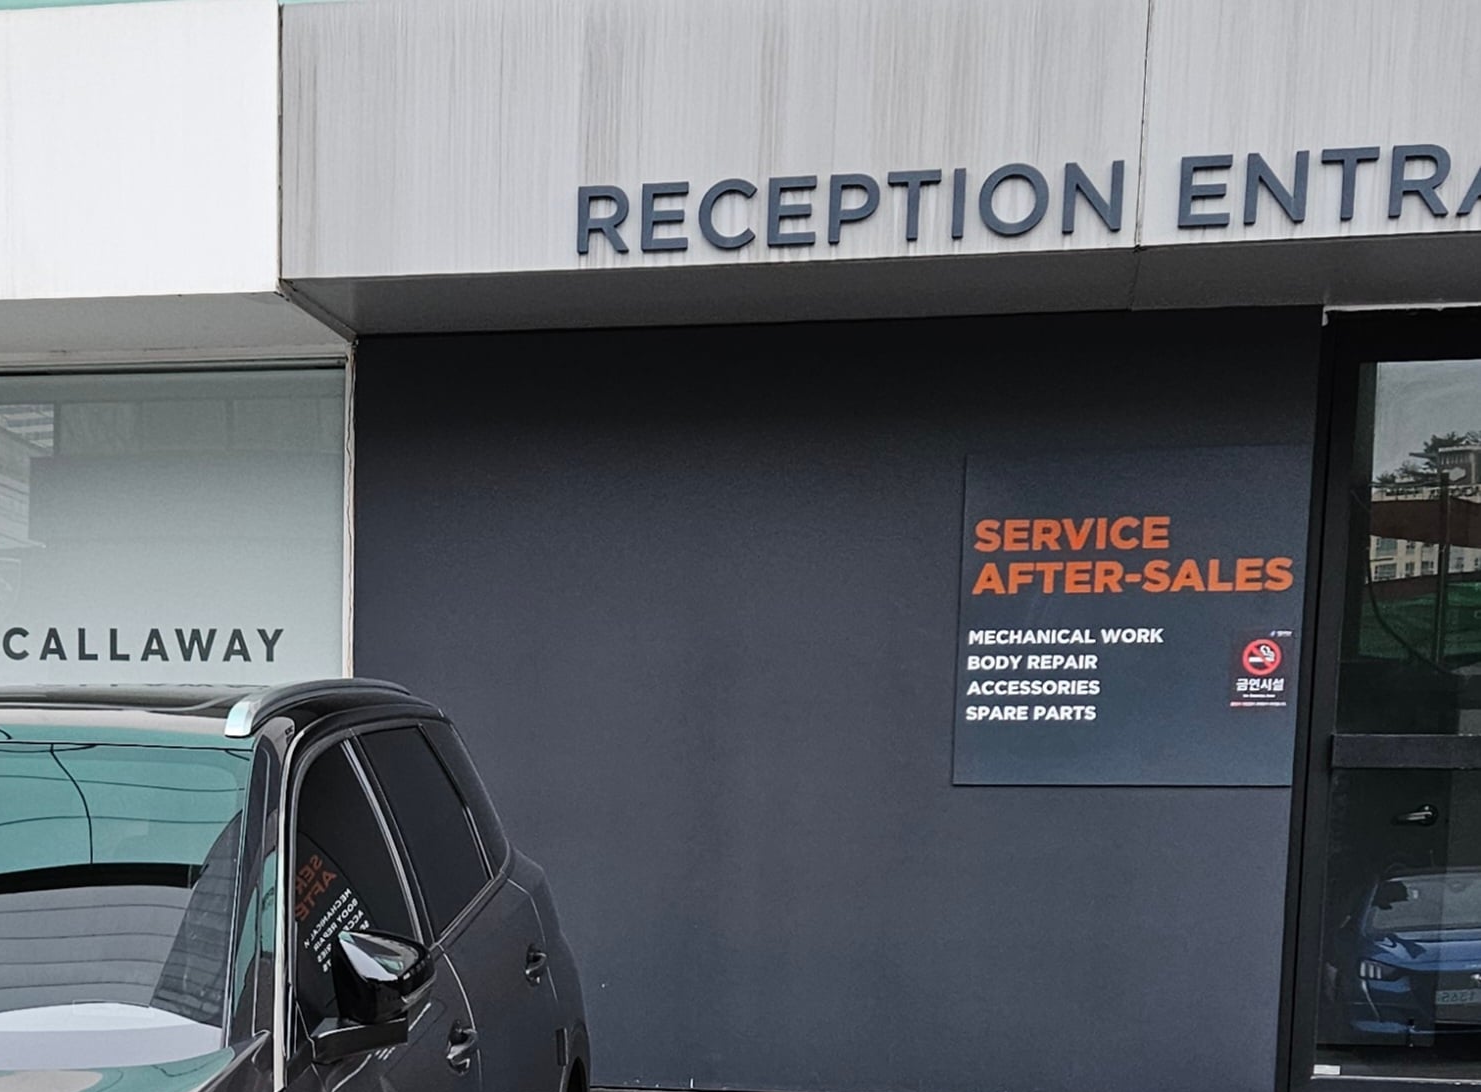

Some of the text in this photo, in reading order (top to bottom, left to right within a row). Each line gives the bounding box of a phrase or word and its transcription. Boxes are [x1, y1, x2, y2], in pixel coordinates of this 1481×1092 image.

[576, 159, 1125, 255] RECEPTION
[974, 515, 1171, 553] SERVICE
[971, 557, 1294, 596] AFTER-SALES
[2, 627, 285, 663] CALLAWAY
[967, 626, 1165, 647] MECHANICAL WORK
[966, 653, 1099, 671] BODY REPAIR
[966, 679, 1101, 697] ACCESSORIES
[1236, 678, 1285, 692] 금연시설
[965, 704, 1097, 722] SPARE PARTS
